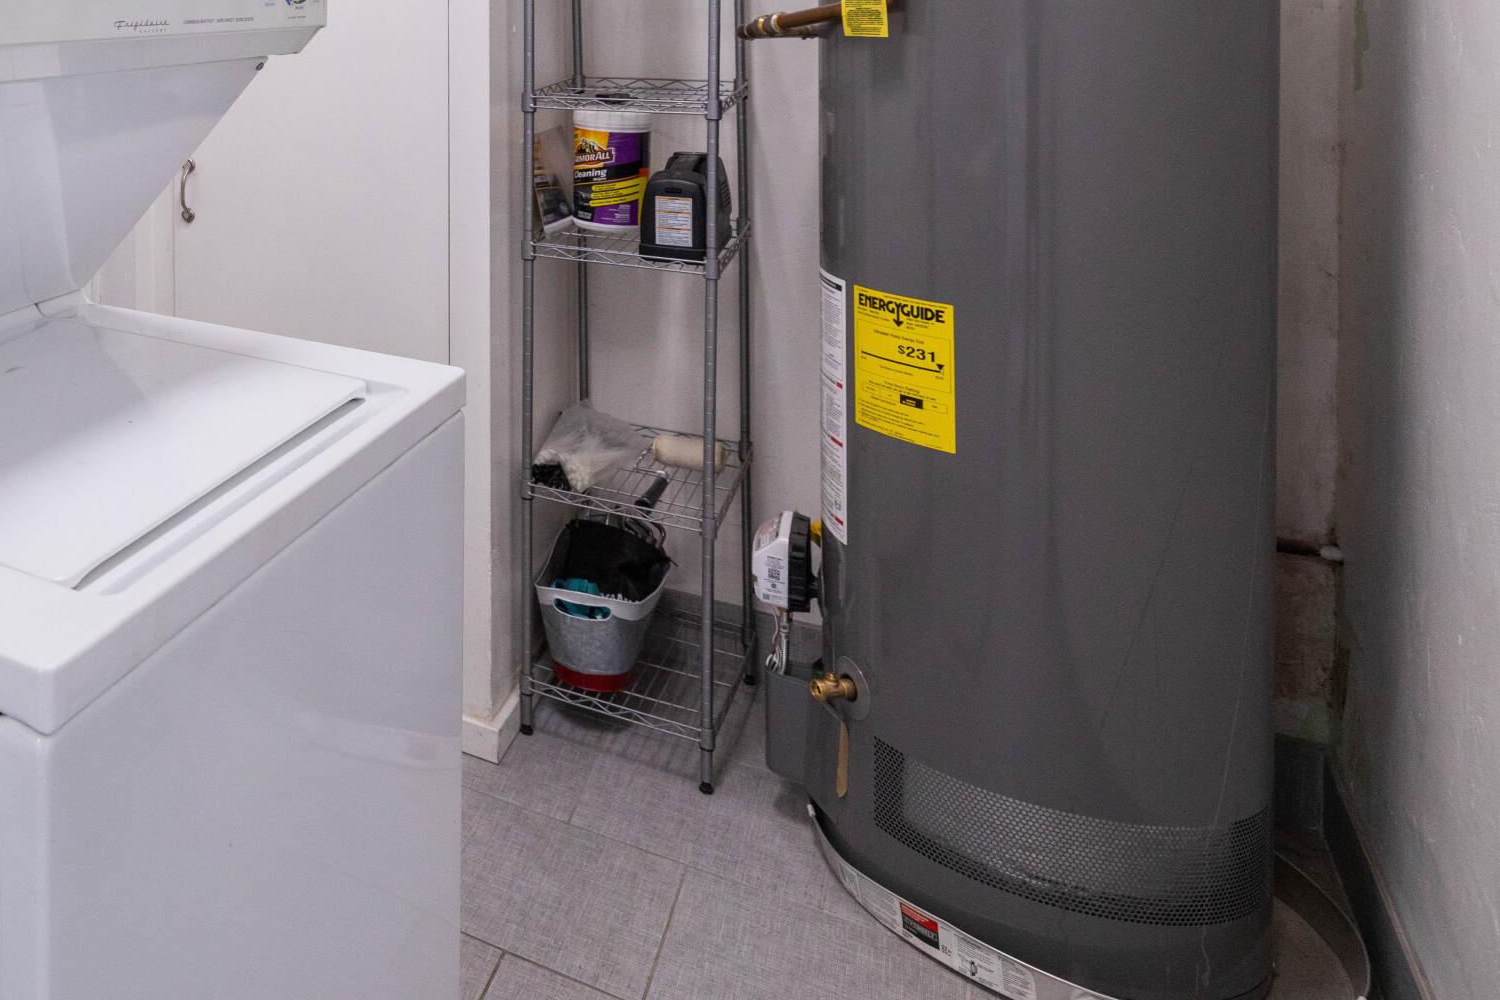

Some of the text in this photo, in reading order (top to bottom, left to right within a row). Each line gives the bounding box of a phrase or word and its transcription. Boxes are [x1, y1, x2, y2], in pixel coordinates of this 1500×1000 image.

[574, 168, 607, 178] Cleaning
[858, 293, 945, 324] ENERGYGUIDE
[897, 345, 935, 362] $231
